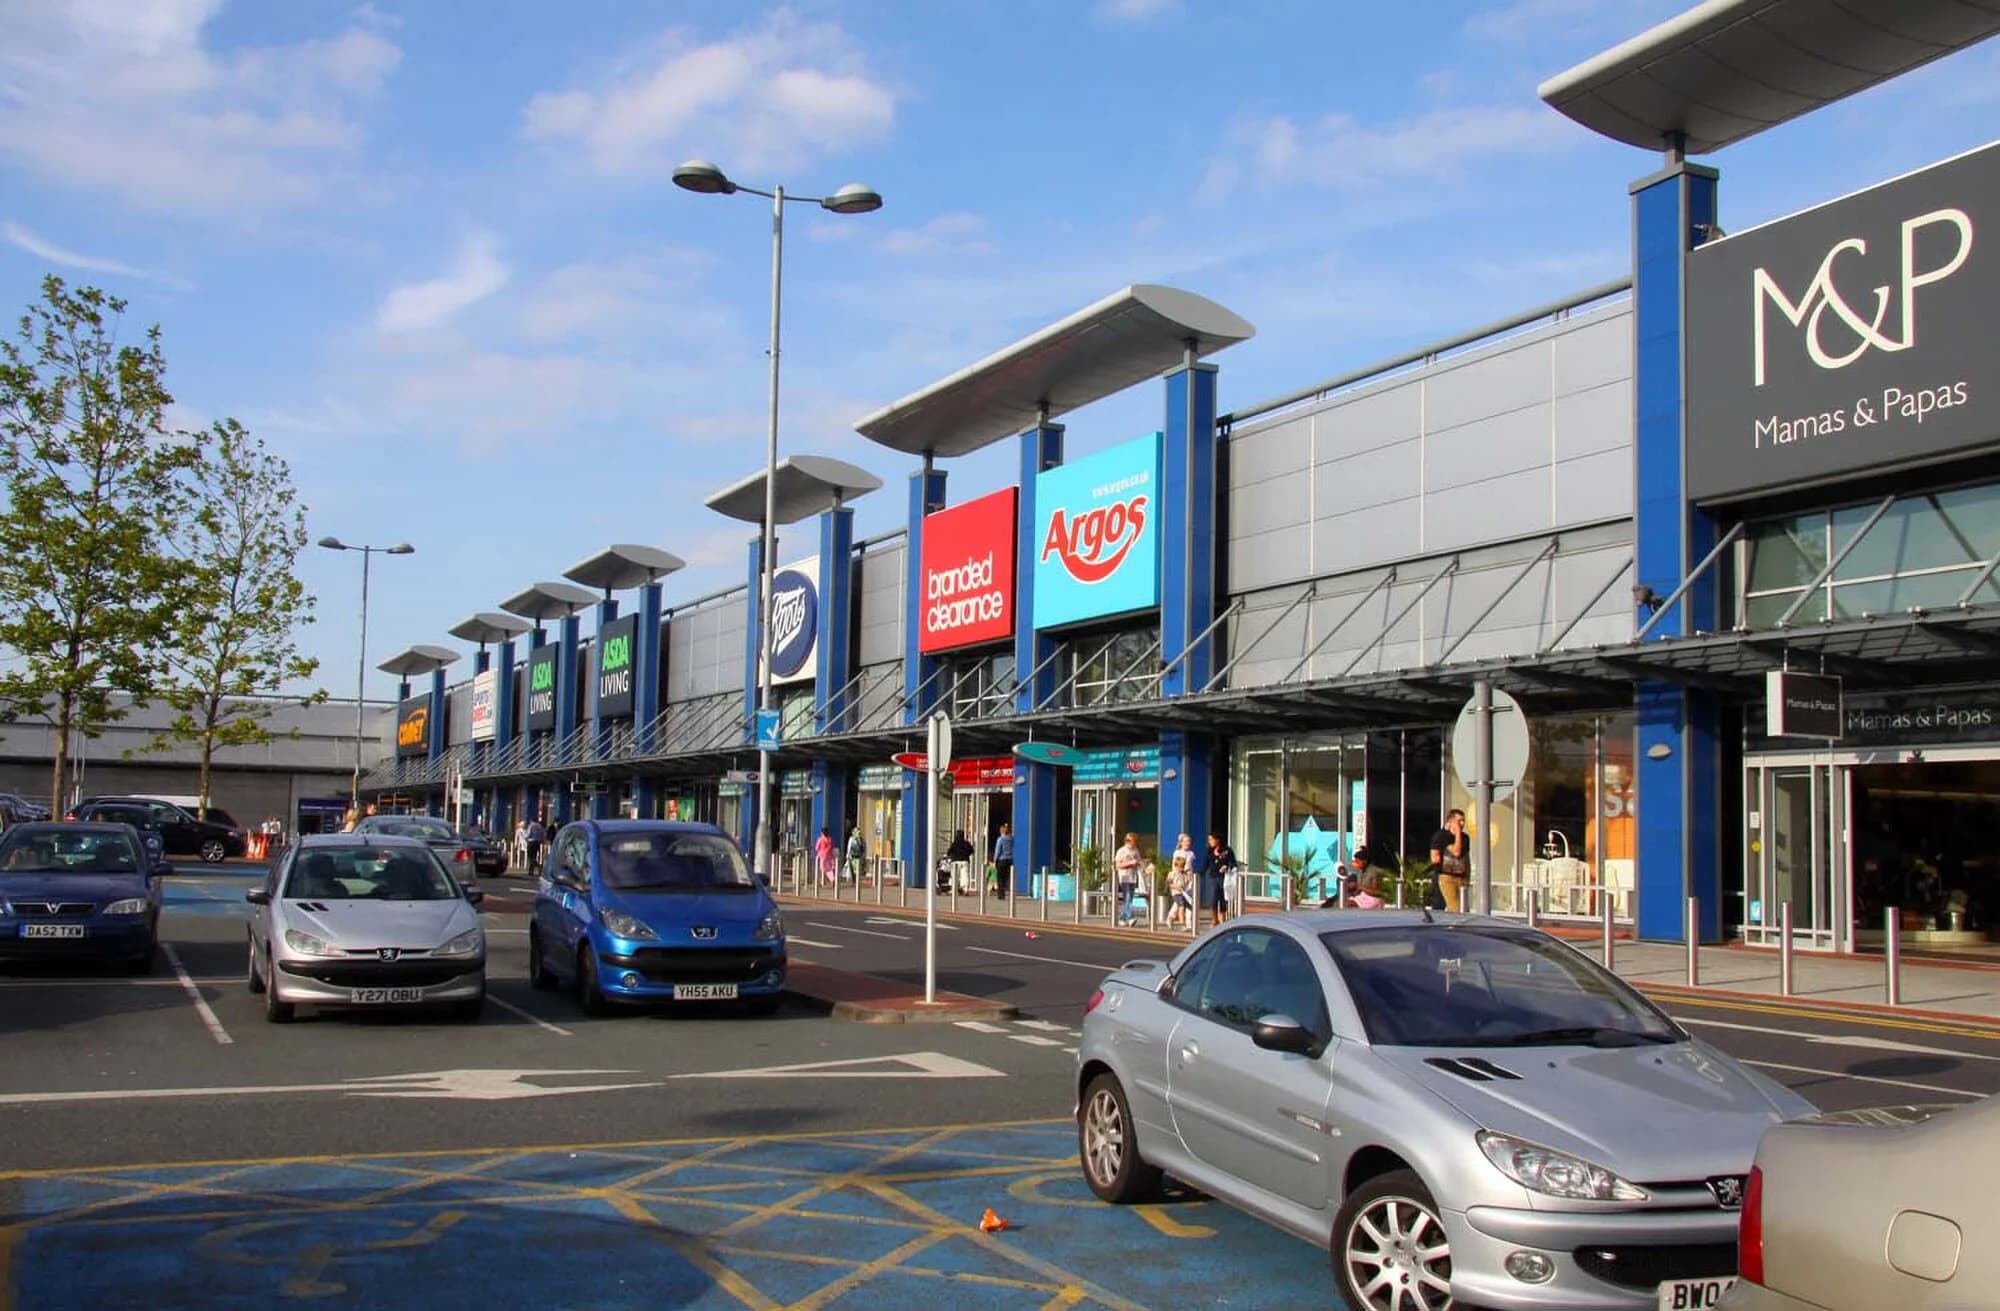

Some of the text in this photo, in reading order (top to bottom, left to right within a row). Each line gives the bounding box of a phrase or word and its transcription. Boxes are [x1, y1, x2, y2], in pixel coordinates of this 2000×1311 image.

[1754, 208, 1973, 386] M&P
[1755, 381, 1968, 448] Mamas & Papas
[1041, 495, 1148, 583] Argos
[928, 550, 993, 600] branded
[771, 586, 806, 655] Boots
[927, 591, 1004, 632] clearance
[602, 634, 629, 671] ASDA
[531, 661, 552, 691] ASDA
[600, 670, 629, 698] LIVING
[530, 691, 552, 714] LIVING
[1848, 704, 1992, 732] Mamas & Papas
[28, 926, 81, 936] DA52 TXW
[679, 986, 733, 997] YH55 AKU
